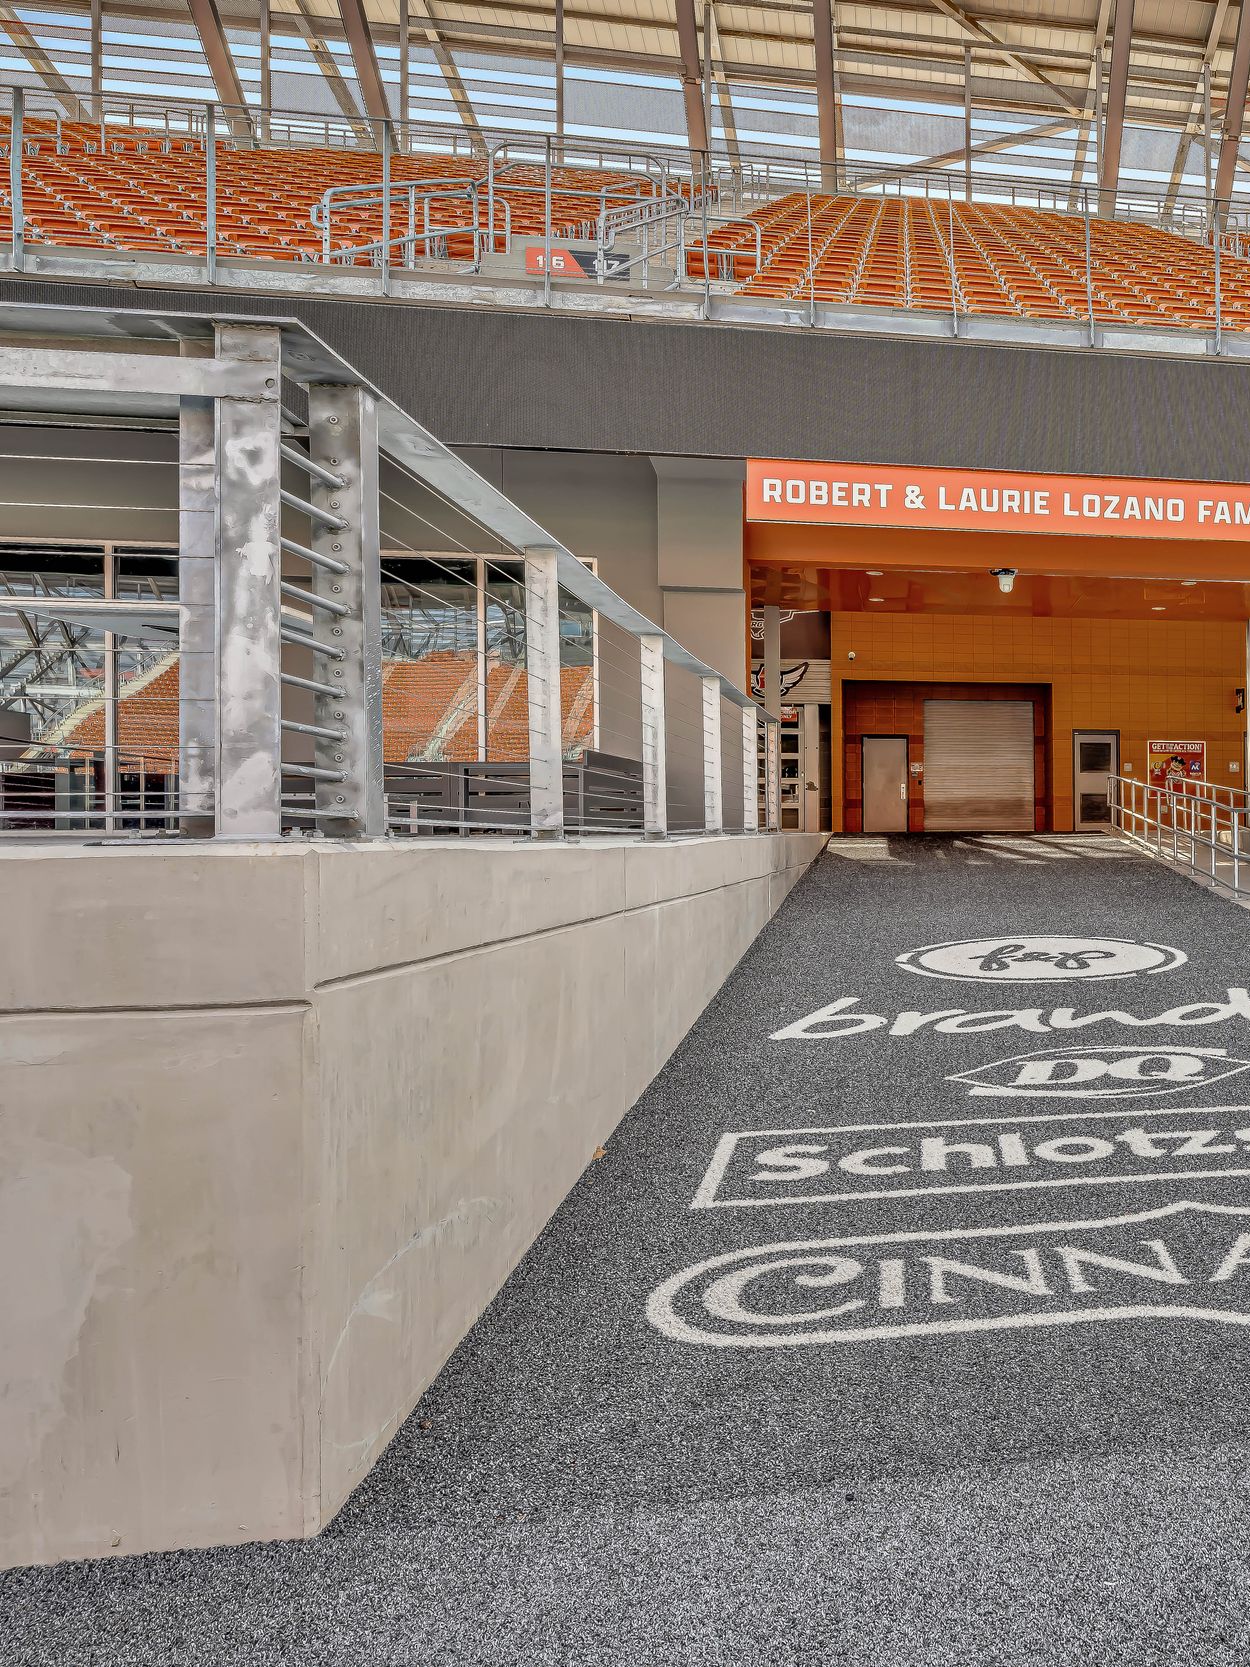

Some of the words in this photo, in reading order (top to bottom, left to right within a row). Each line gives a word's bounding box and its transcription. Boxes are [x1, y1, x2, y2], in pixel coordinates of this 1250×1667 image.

[537, 255, 564, 269] 16
[762, 478, 893, 508] ROBERT
[904, 485, 926, 509] &
[938, 486, 1050, 515] LAURIE
[1063, 492, 1185, 522] LOZANO
[1008, 1055, 1206, 1086] DQ
